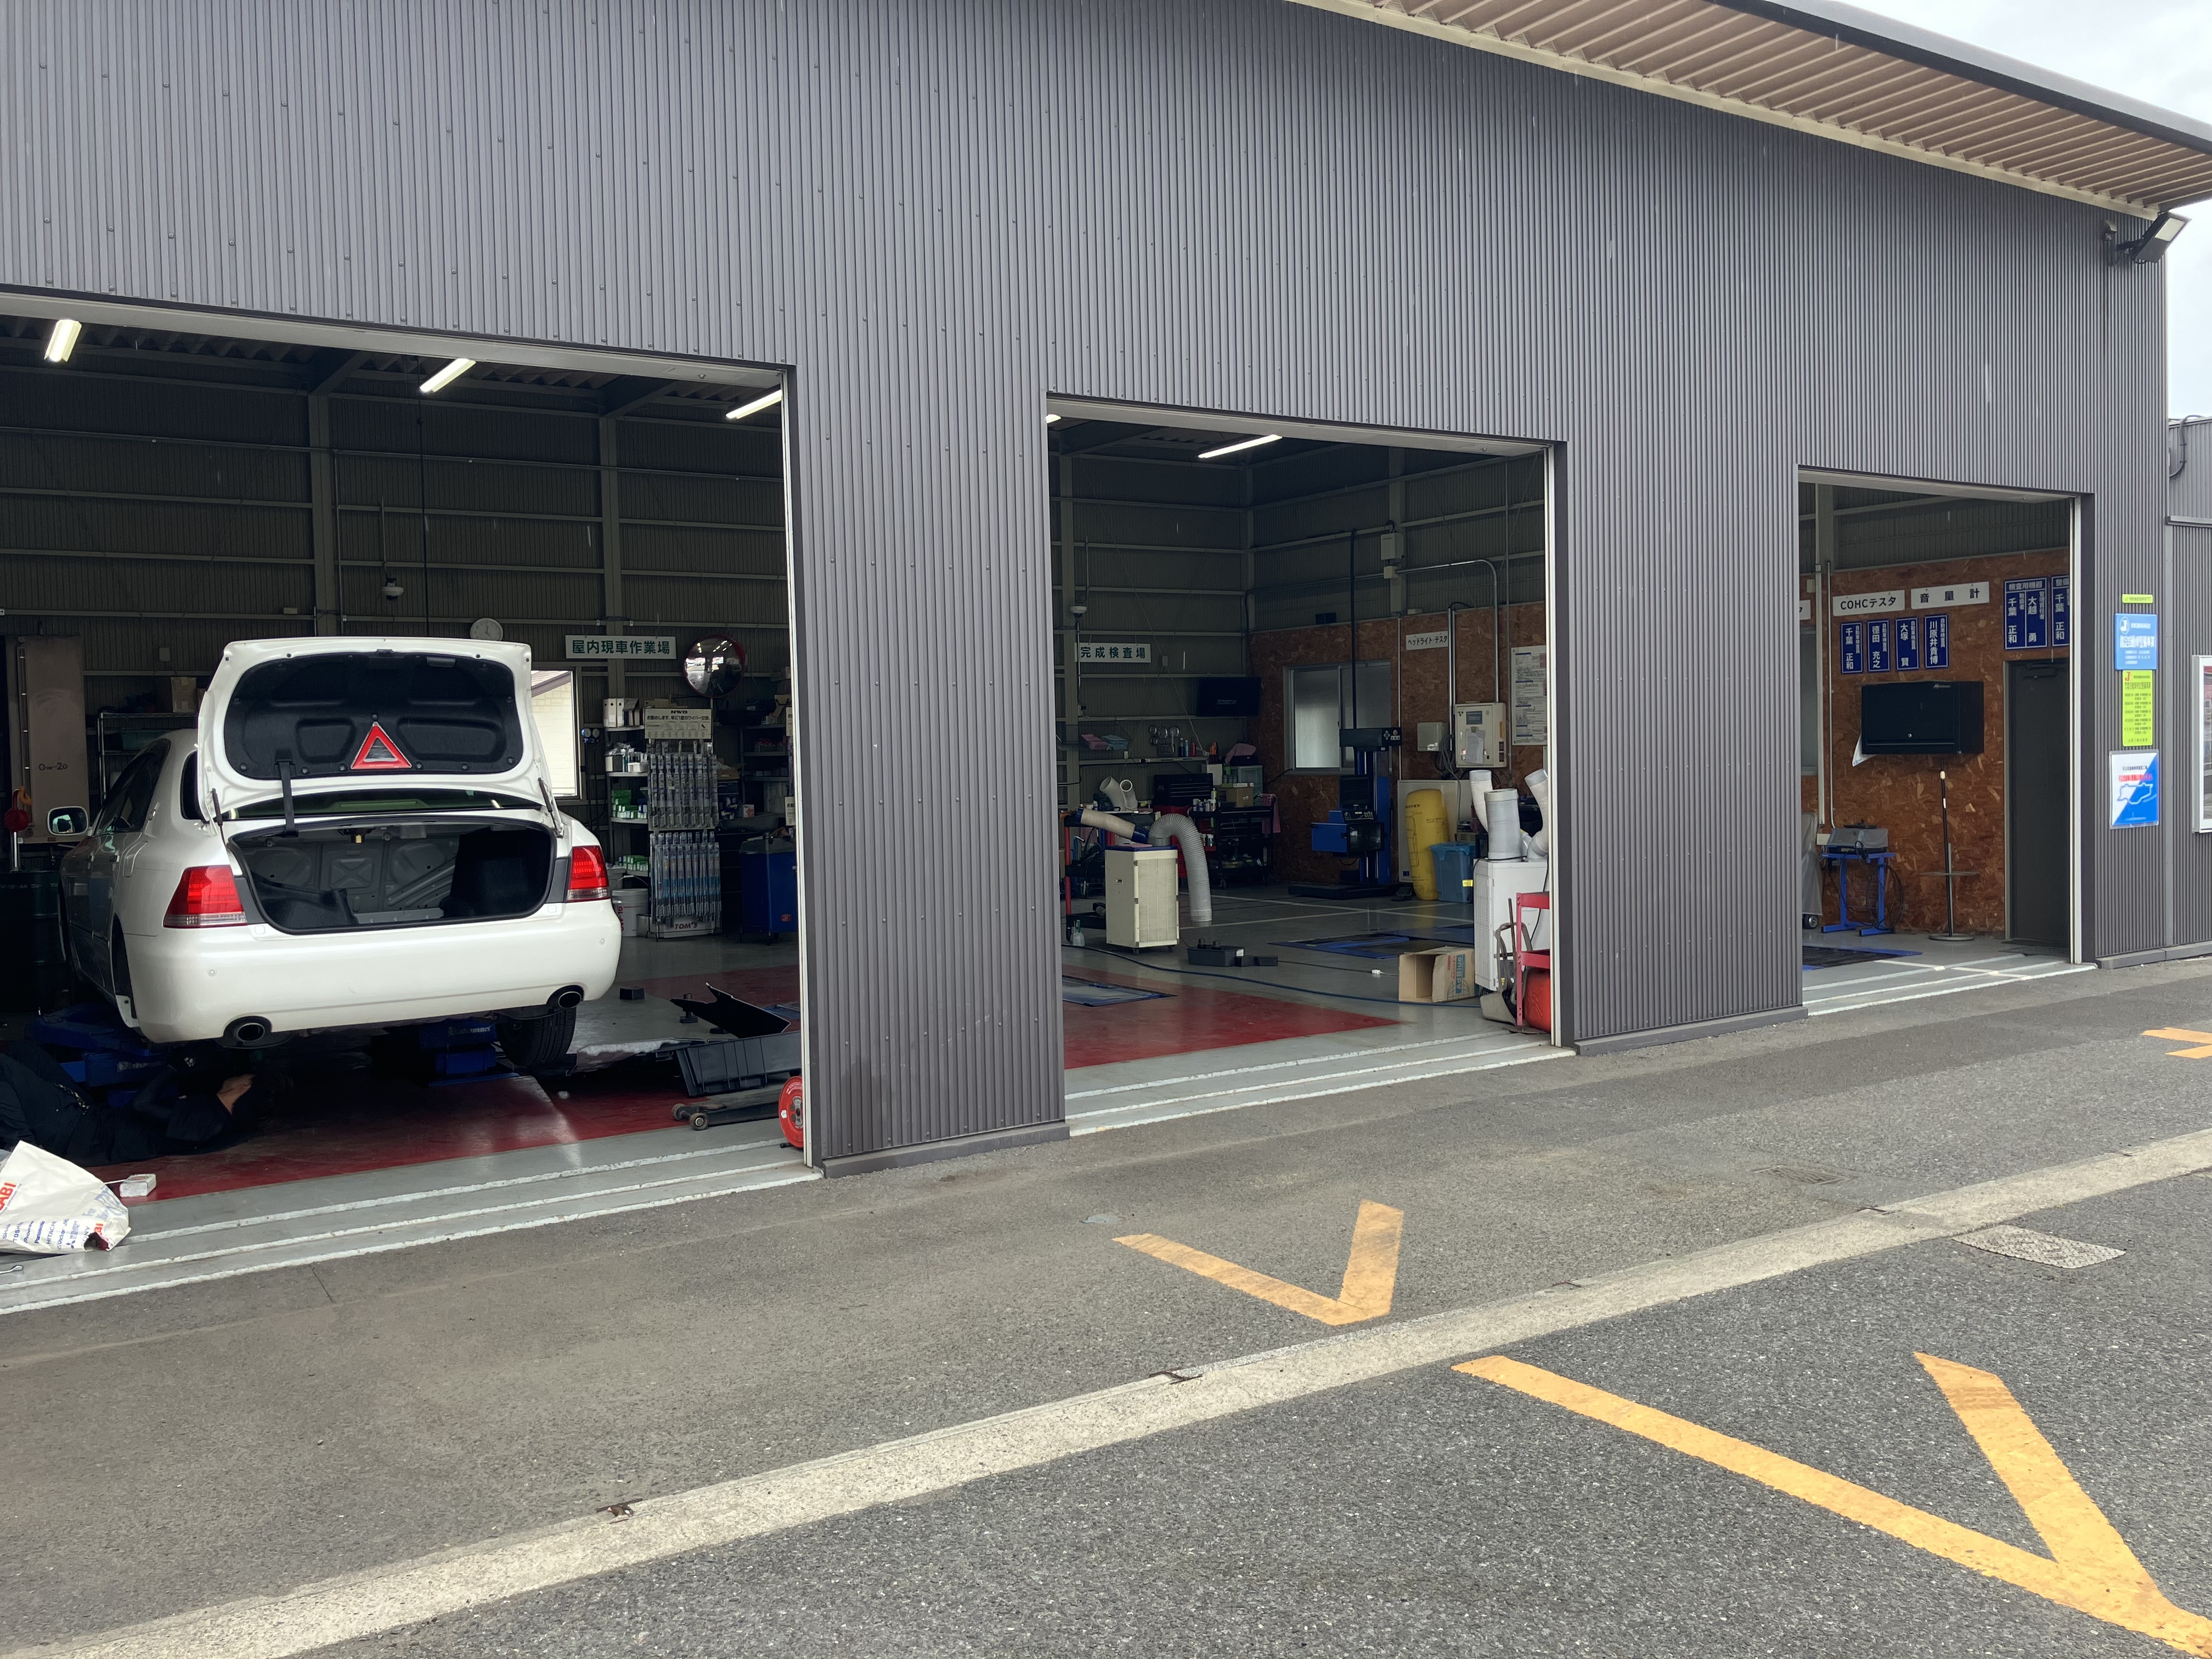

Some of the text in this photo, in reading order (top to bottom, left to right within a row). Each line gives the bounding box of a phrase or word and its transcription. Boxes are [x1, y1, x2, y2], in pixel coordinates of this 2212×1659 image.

[1841, 596, 1897, 610] COHCテスタ
[2055, 594, 2065, 640] 千葉 正和
[2008, 597, 2017, 644] 千葉 正和
[572, 640, 670, 654] 屋内現車作業場
[1080, 646, 1146, 659] 完成検査場
[1845, 628, 1854, 670] 千葉 正和
